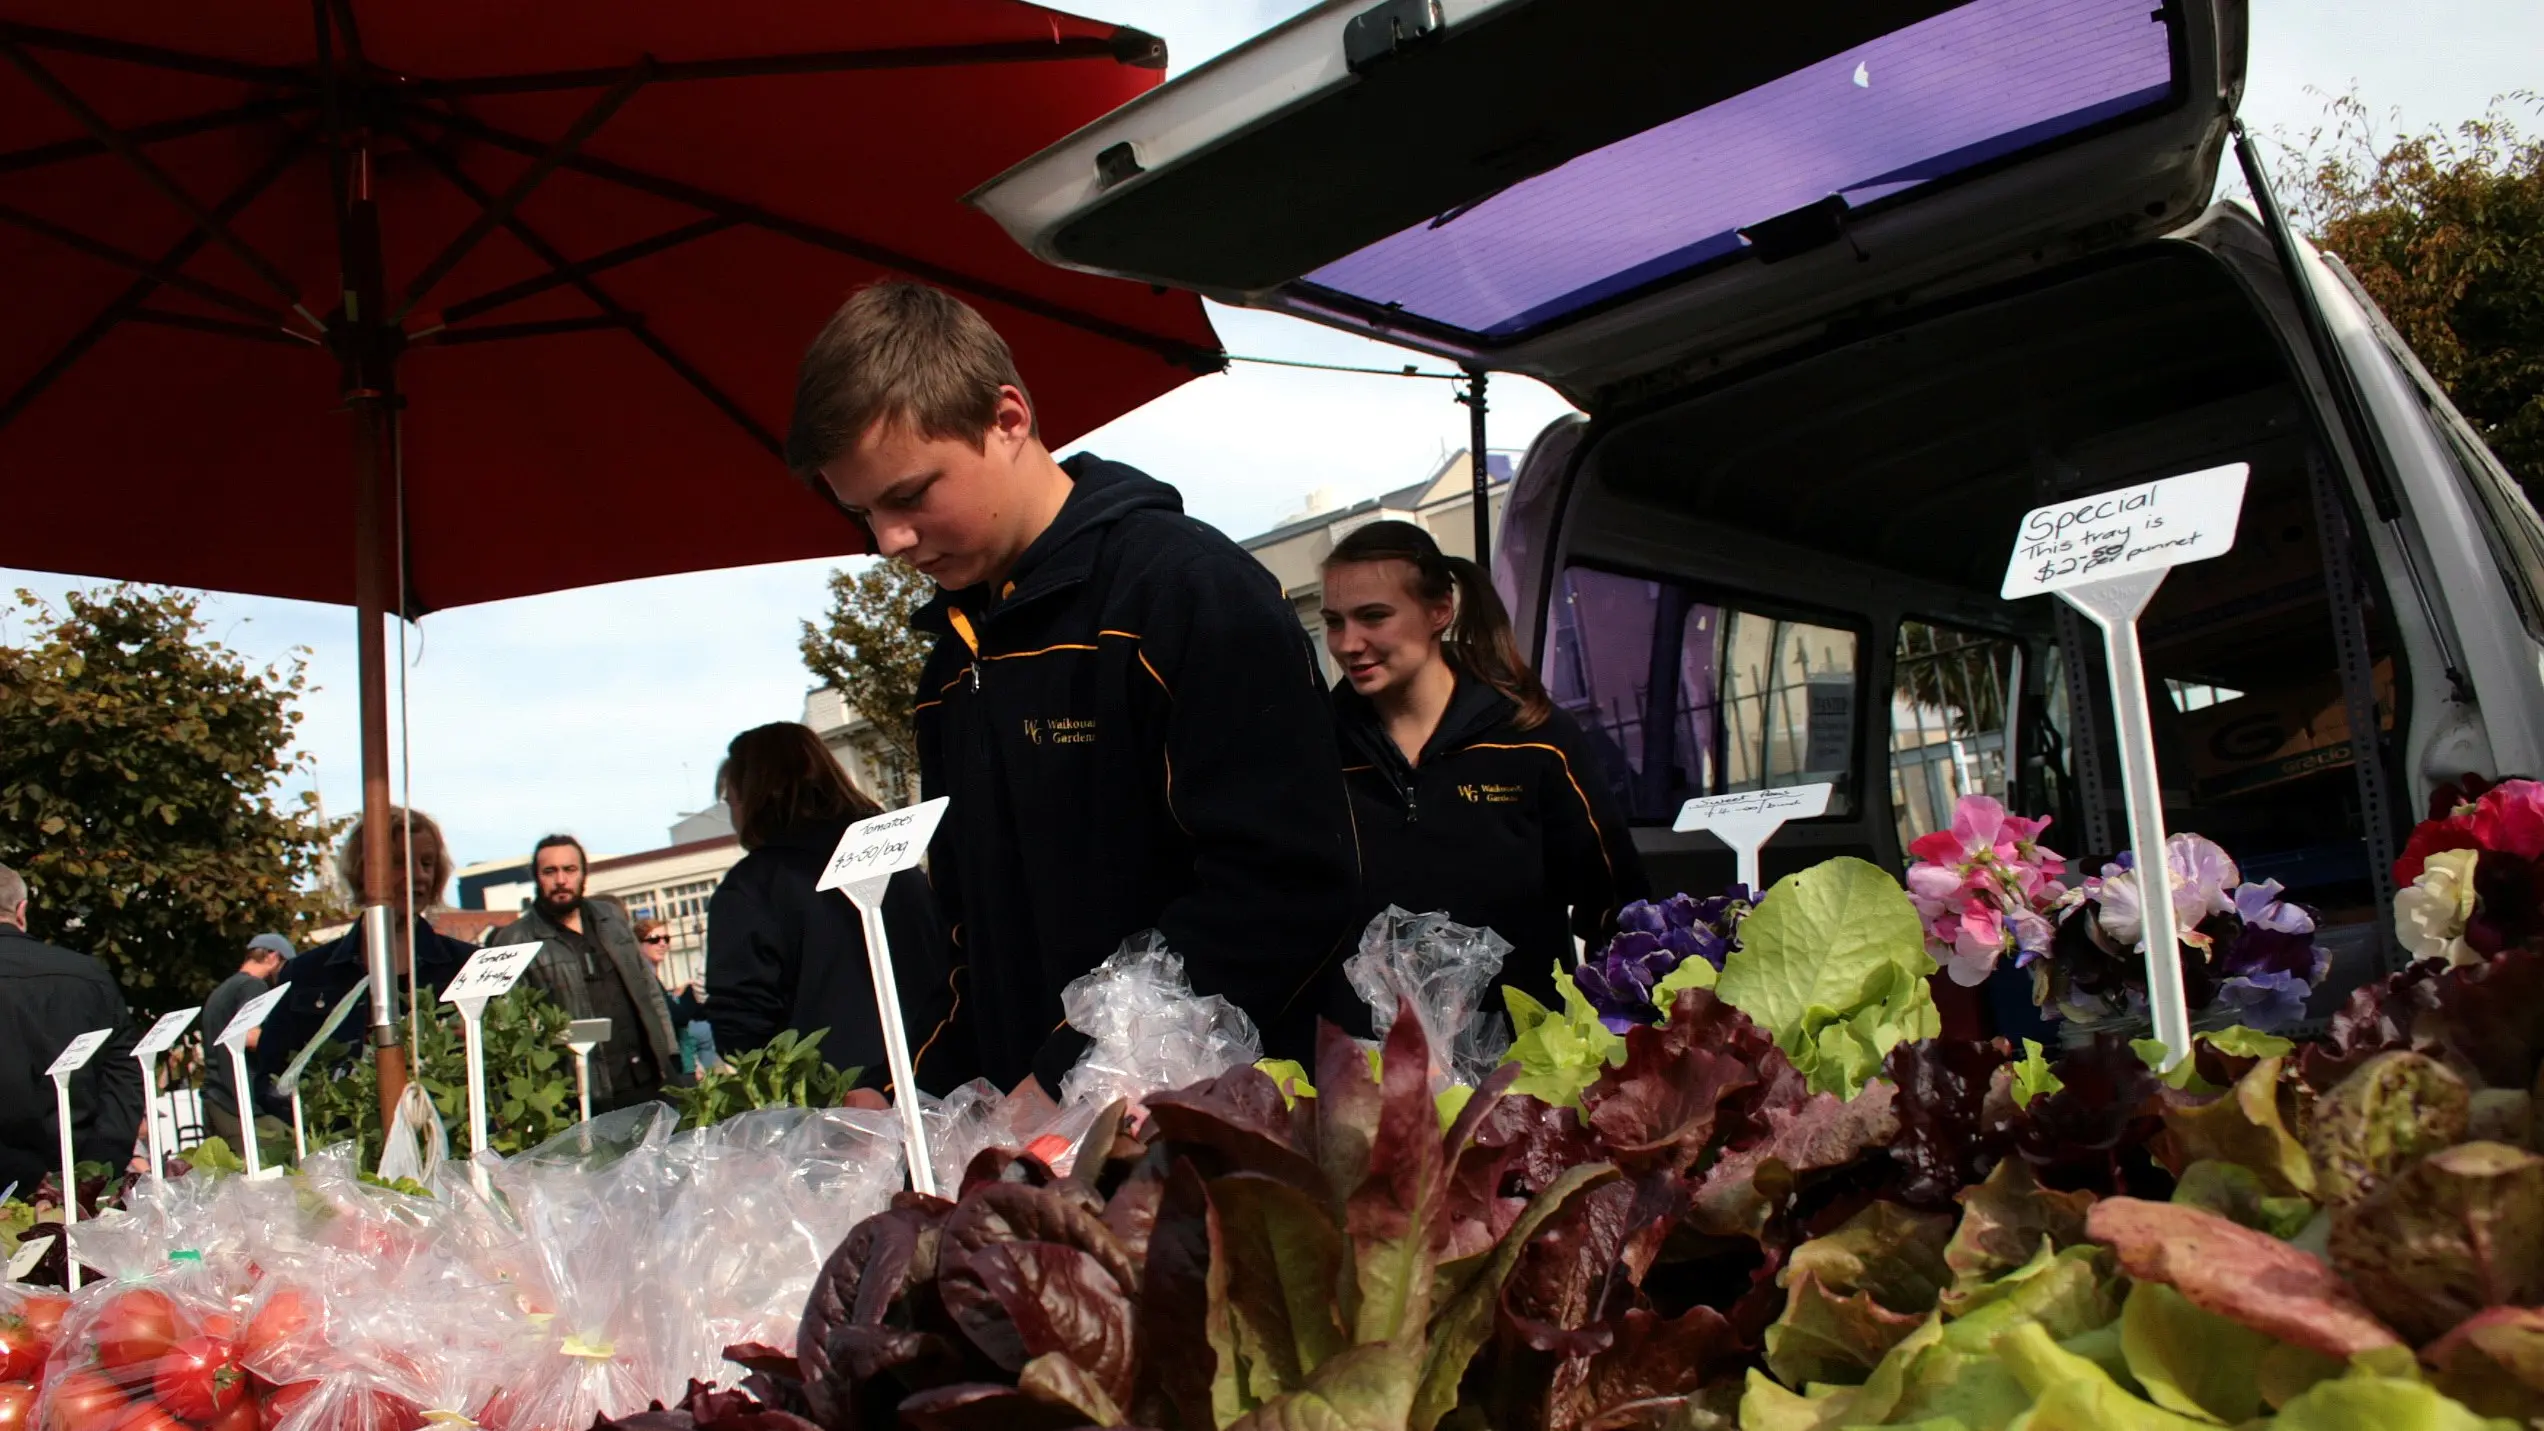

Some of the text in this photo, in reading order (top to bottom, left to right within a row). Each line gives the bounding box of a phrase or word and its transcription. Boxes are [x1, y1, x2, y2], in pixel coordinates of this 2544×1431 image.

[2023, 484, 2158, 541] Special
[2020, 514, 2165, 560] This tray is
[2127, 531, 2203, 562] punnet
[860, 813, 916, 836] Tomatoes
